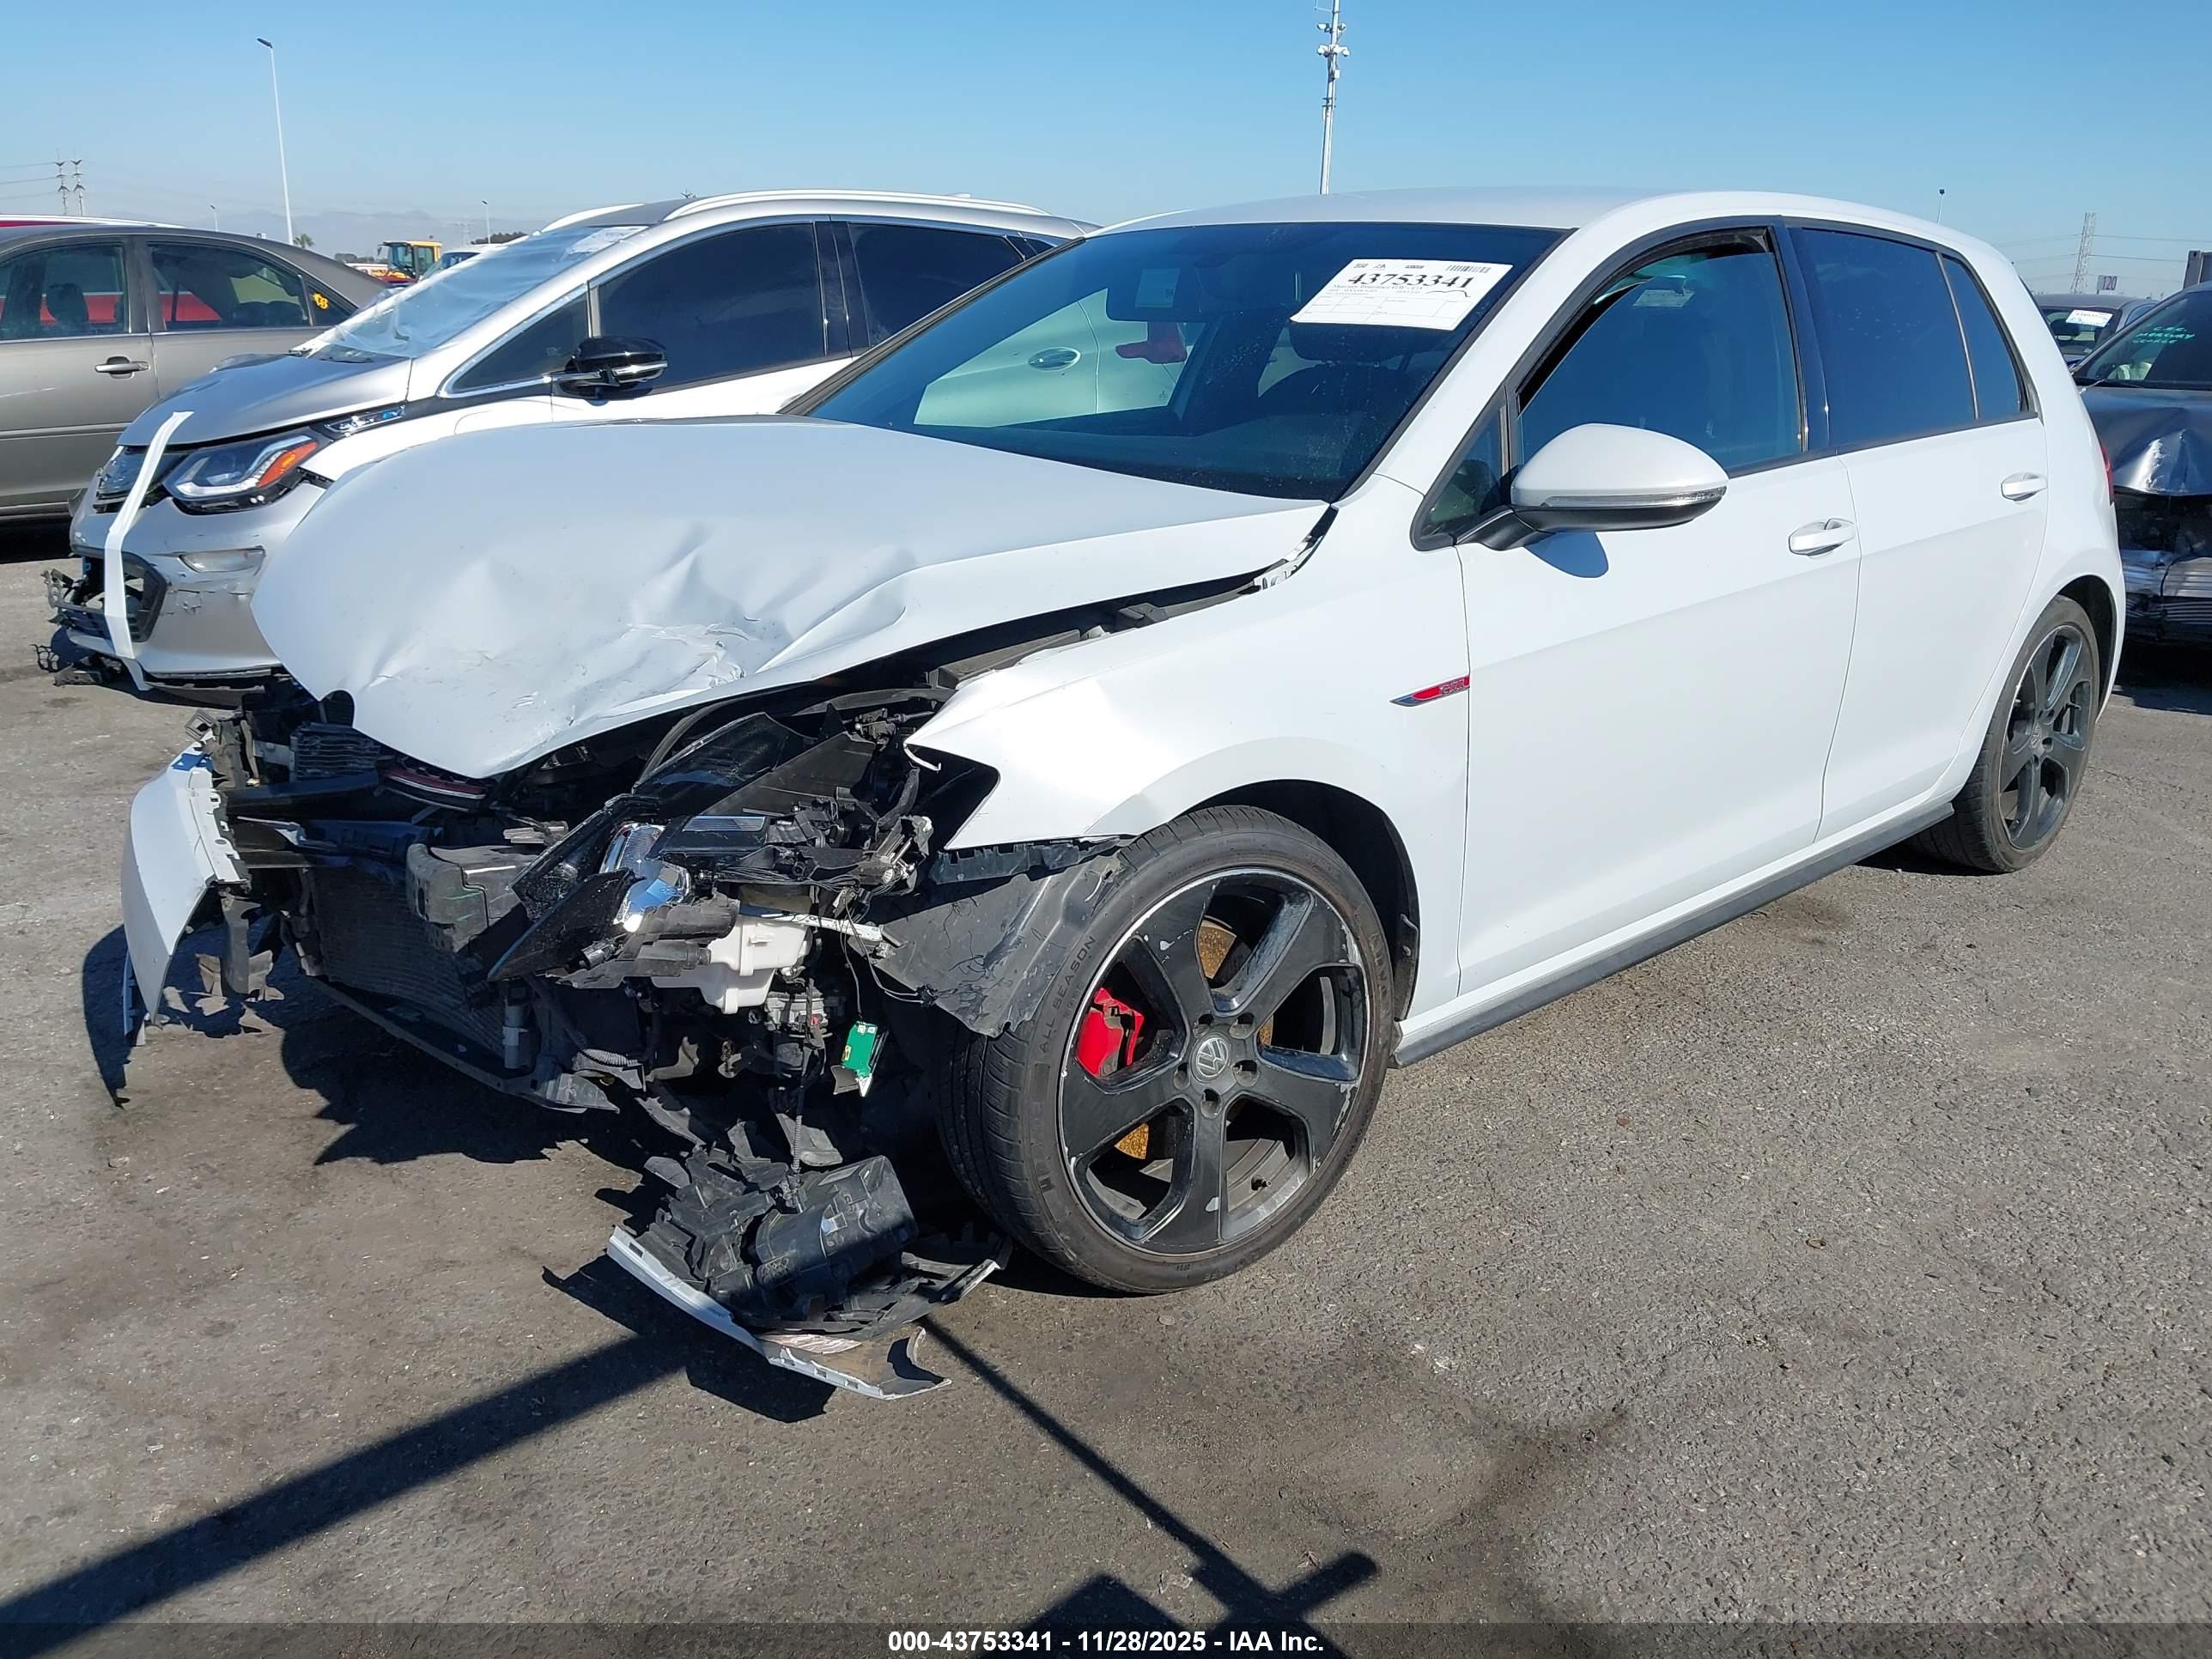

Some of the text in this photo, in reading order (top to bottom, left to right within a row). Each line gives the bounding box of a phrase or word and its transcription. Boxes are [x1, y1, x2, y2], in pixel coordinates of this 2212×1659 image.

[1347, 272, 1475, 289] 43753341
[1039, 1018, 1055, 1053] ALL
[1053, 936, 1096, 1010] SEASON
